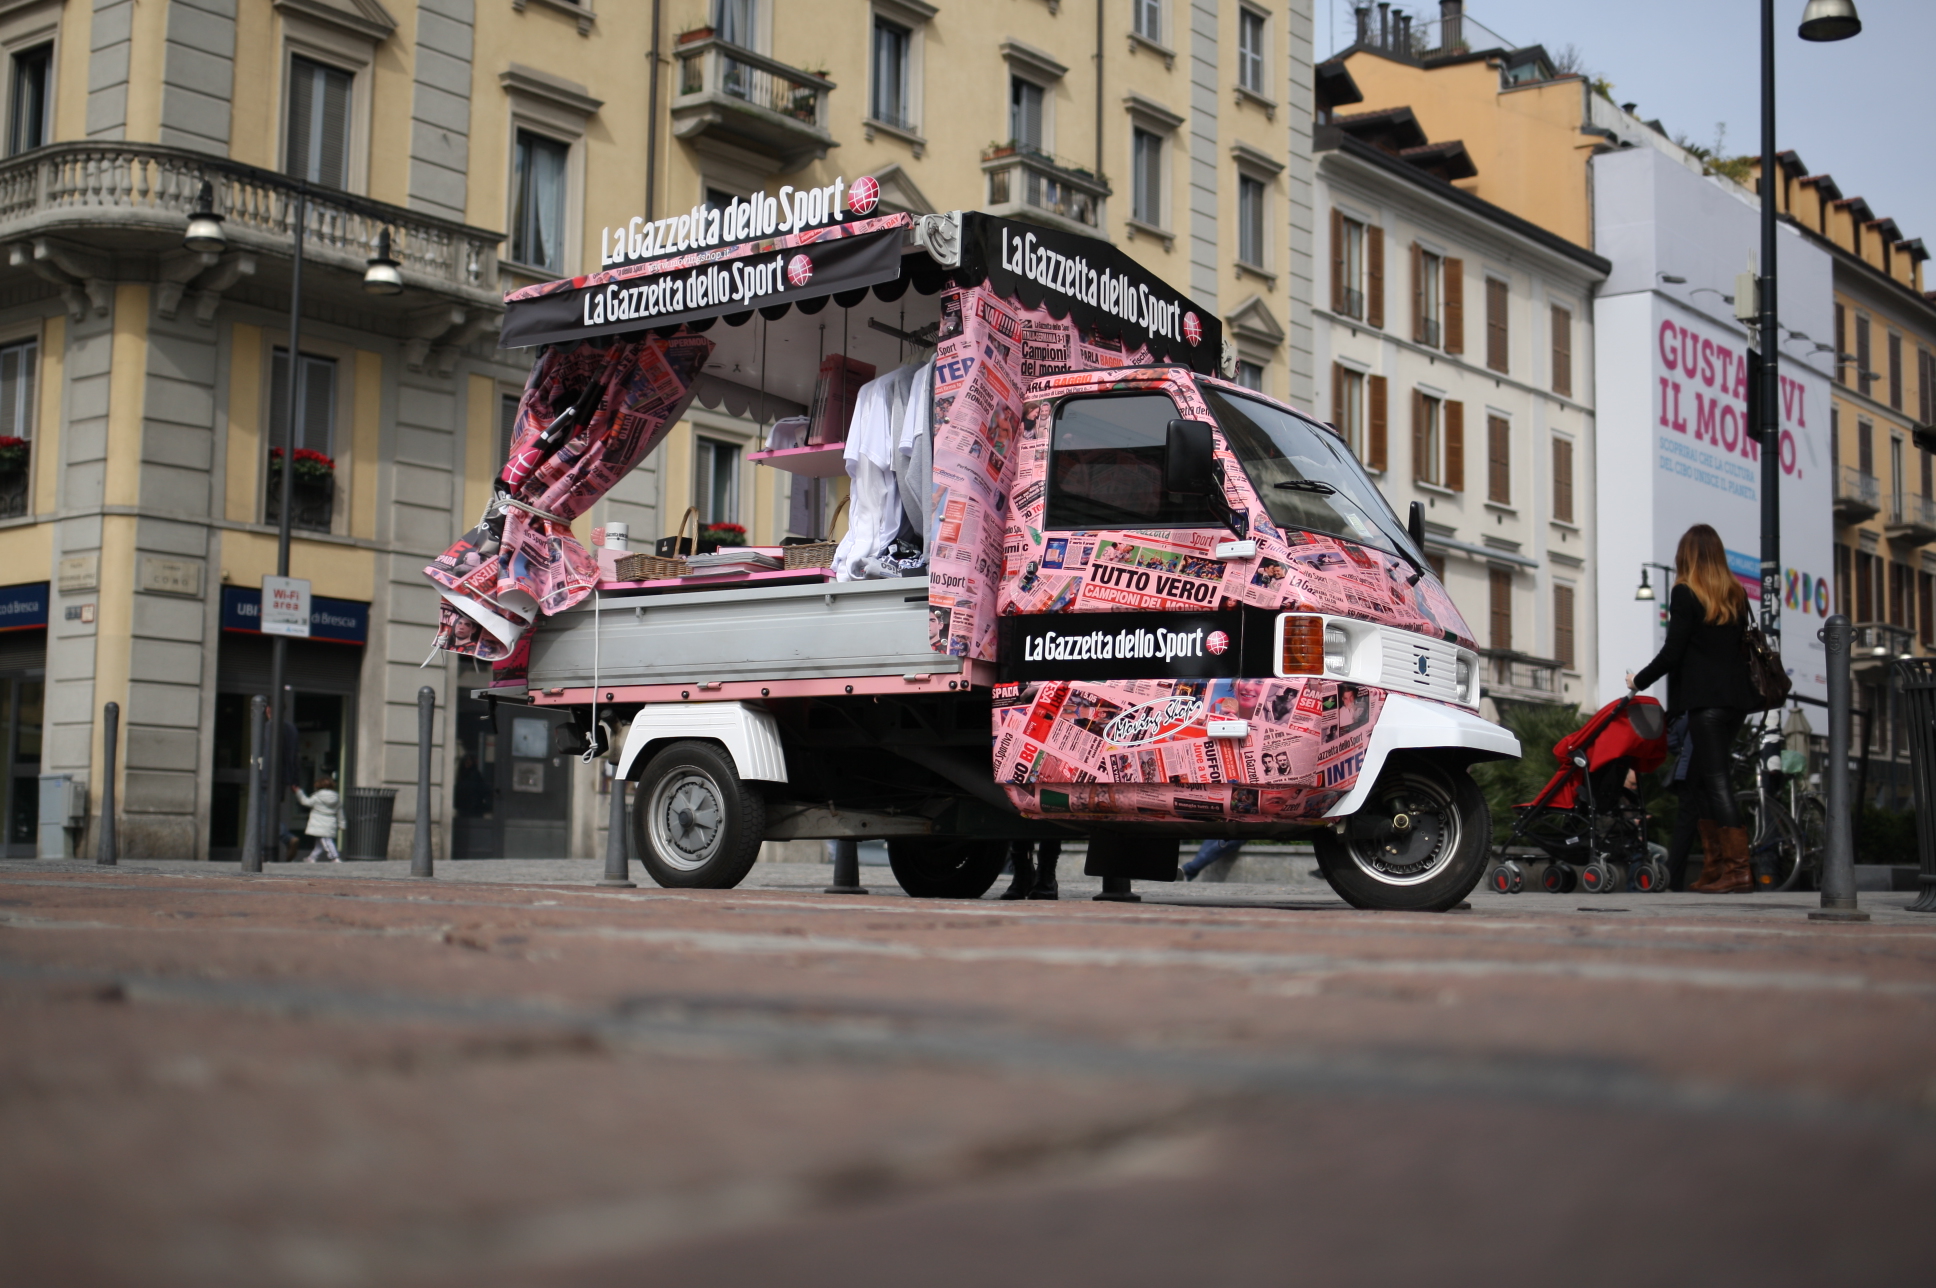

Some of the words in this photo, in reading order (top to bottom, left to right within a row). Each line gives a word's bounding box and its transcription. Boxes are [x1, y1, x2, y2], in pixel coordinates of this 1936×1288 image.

[601, 226, 626, 266] La
[627, 203, 720, 260] Gazzetta
[722, 190, 777, 242] dello
[778, 175, 844, 235] Sport
[647, 248, 731, 273] www.movingshop.it
[583, 292, 605, 326] La
[606, 275, 684, 322] Gazzetta
[686, 265, 730, 308] dello
[731, 253, 785, 306] Sport
[1002, 226, 1023, 275] La
[1024, 231, 1098, 307] Gazzetta
[1100, 267, 1137, 323] dello
[1138, 283, 1181, 343] Sport
[938, 342, 957, 357] Sport
[1021, 340, 1067, 362] Campioni
[1021, 360, 1036, 376] del
[1659, 319, 1806, 429] GUSTAVI
[1659, 376, 1687, 435] IL
[1694, 391, 1803, 480] MONO.
[1699, 451, 1714, 468] CHE
[1724, 460, 1756, 483] CULTURA
[1190, 531, 1214, 547] Sport
[273, 588, 299, 601] Wi-Fi
[941, 573, 966, 588] Sport
[1090, 563, 1151, 591] TUTTO
[1155, 575, 1218, 605] VERO!
[1780, 566, 1830, 618] XPO
[14, 600, 39, 614] Brescia
[273, 600, 299, 612] area
[1085, 584, 1139, 607] CAMPIONI
[1140, 596, 1163, 611] DEL
[237, 602, 258, 617] UBI
[321, 612, 356, 628] Brescia
[1024, 635, 1043, 661] La
[1044, 630, 1113, 661] Gazzetta
[1114, 628, 1155, 658] dello
[1155, 627, 1204, 663] Sport
[1114, 711, 1162, 741] Moving
[1163, 698, 1196, 725] Shop
[995, 732, 1014, 761] Sportiva
[1193, 742, 1204, 765] Juve
[1326, 750, 1367, 787] INTE
